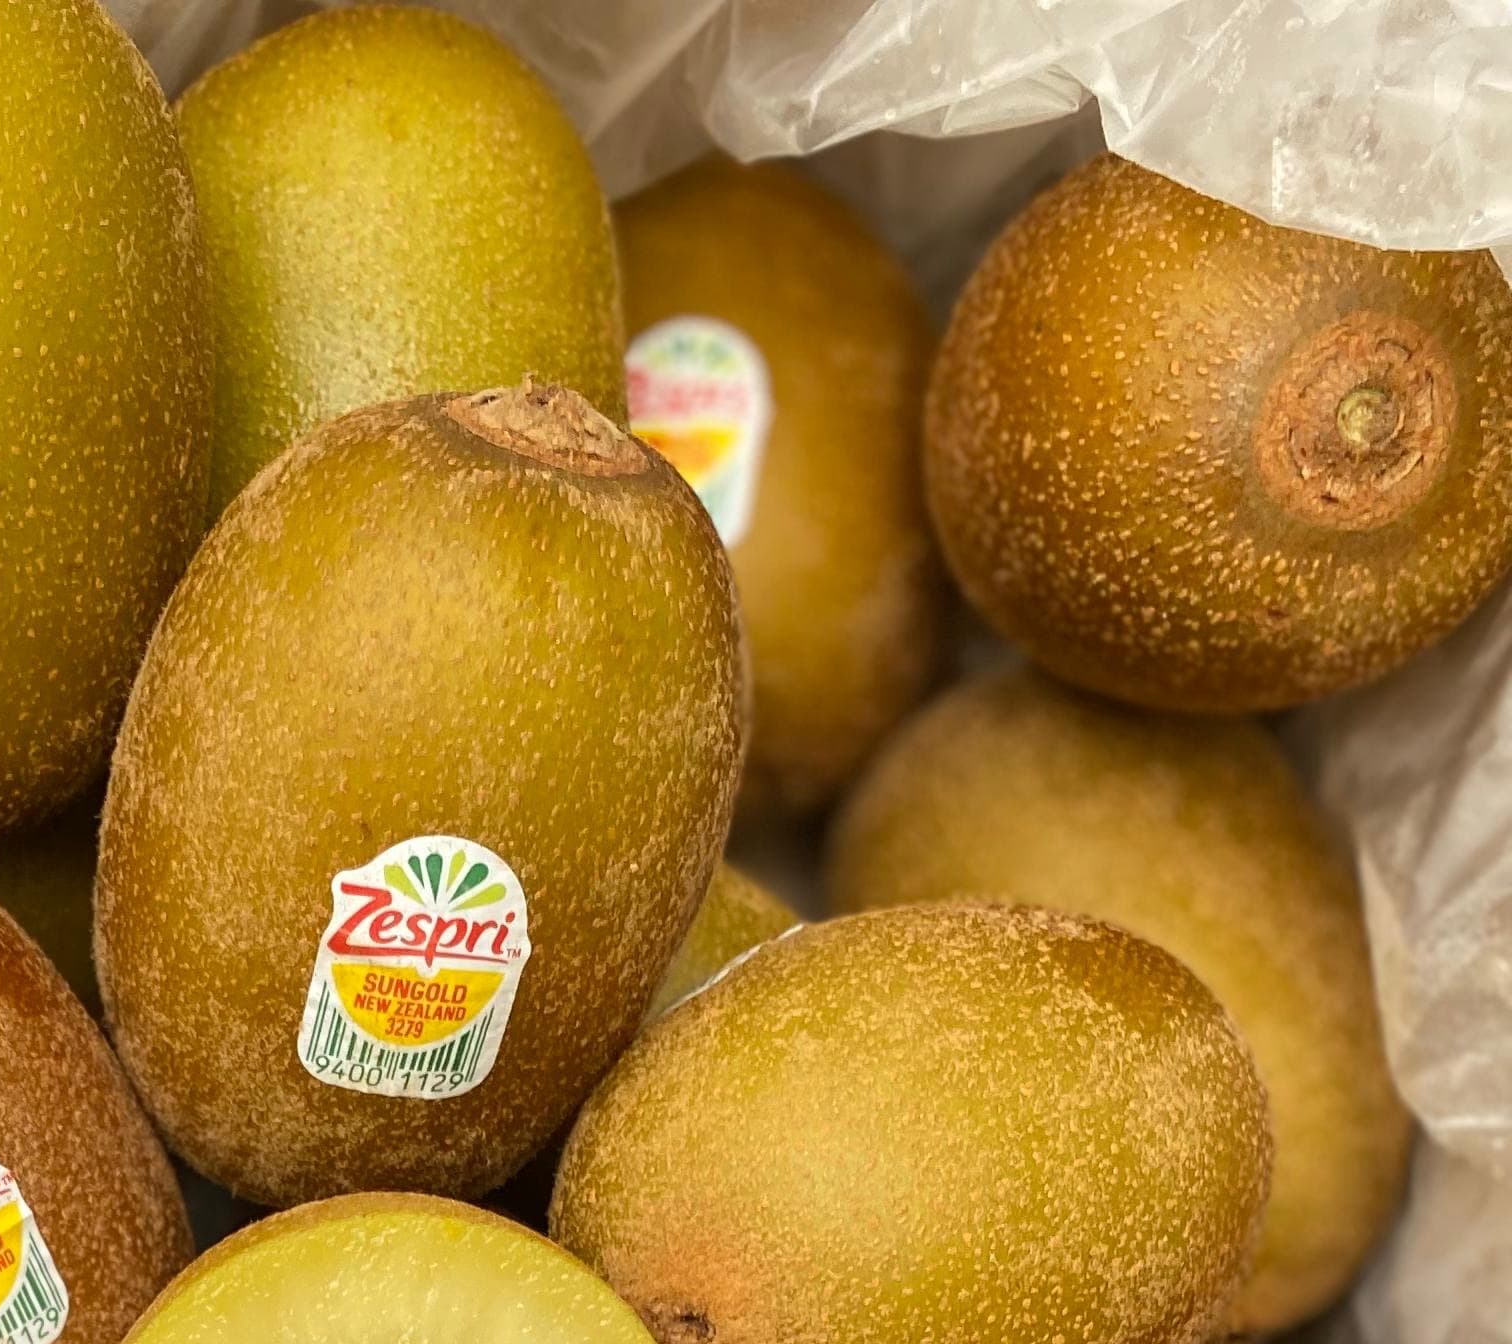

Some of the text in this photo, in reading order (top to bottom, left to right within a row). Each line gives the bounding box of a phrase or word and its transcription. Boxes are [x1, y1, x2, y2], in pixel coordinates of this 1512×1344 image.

[327, 881, 508, 968] Zespri
[363, 972, 468, 1004] SUNGOLD
[353, 994, 467, 1021] NEW ZEALAND
[384, 1018, 424, 1038] 3279
[315, 1055, 464, 1093] 9400 1129
